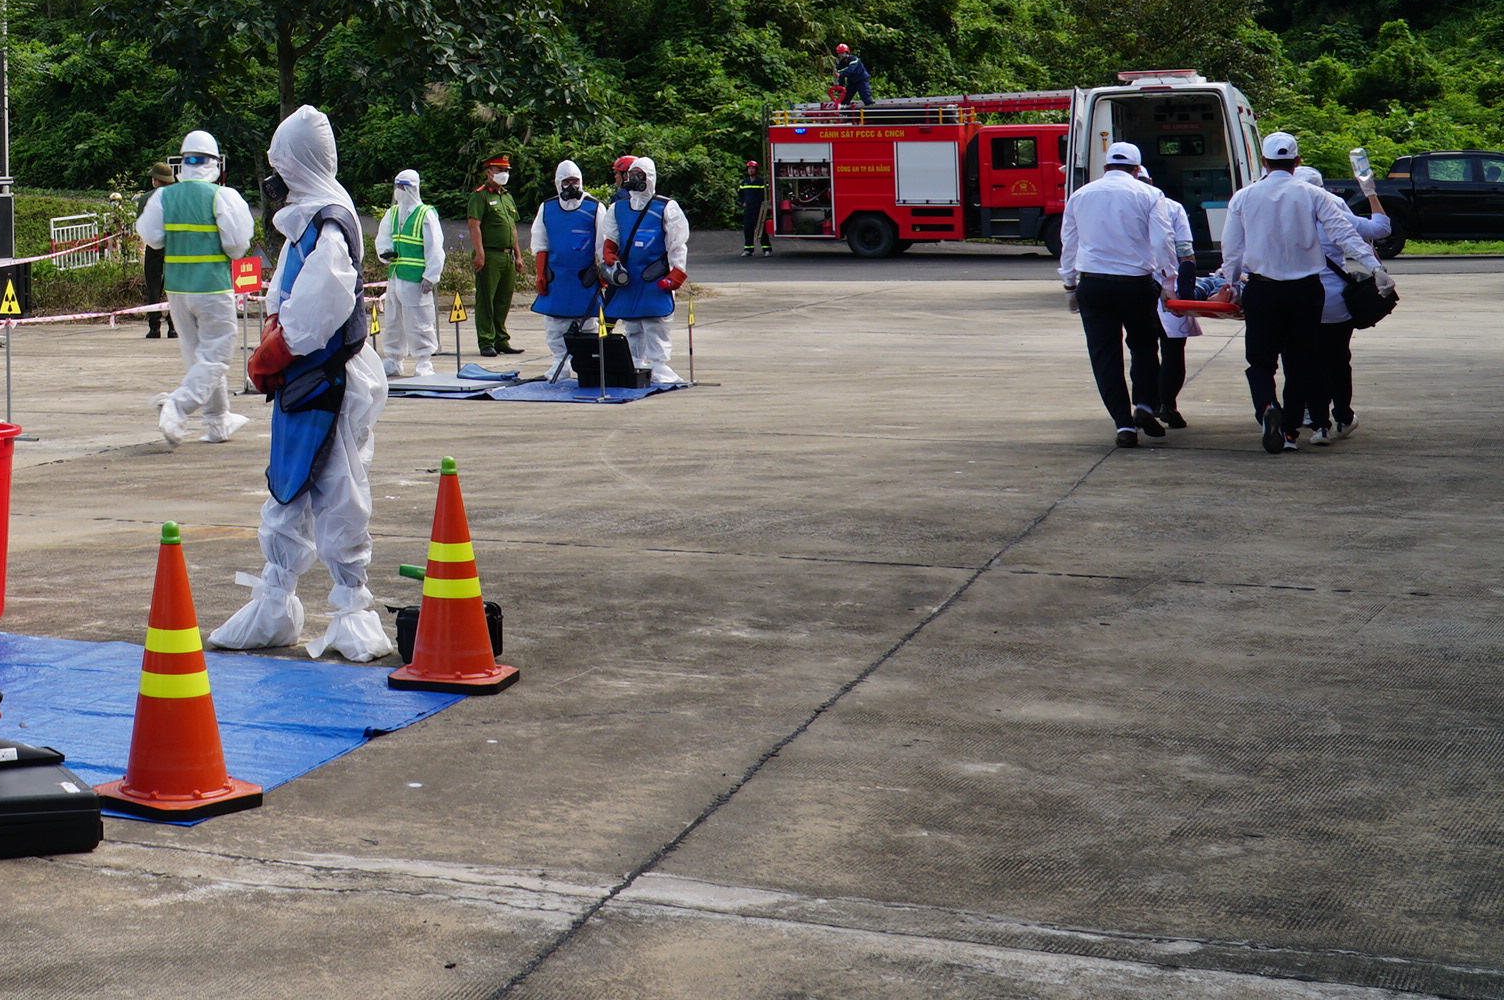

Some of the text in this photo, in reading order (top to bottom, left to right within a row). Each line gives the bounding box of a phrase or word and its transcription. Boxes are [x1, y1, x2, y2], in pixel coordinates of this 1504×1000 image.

[819, 129, 905, 139] CẢNH SÁT PCCC & CNCH
[836, 165, 851, 173] CÔNG
